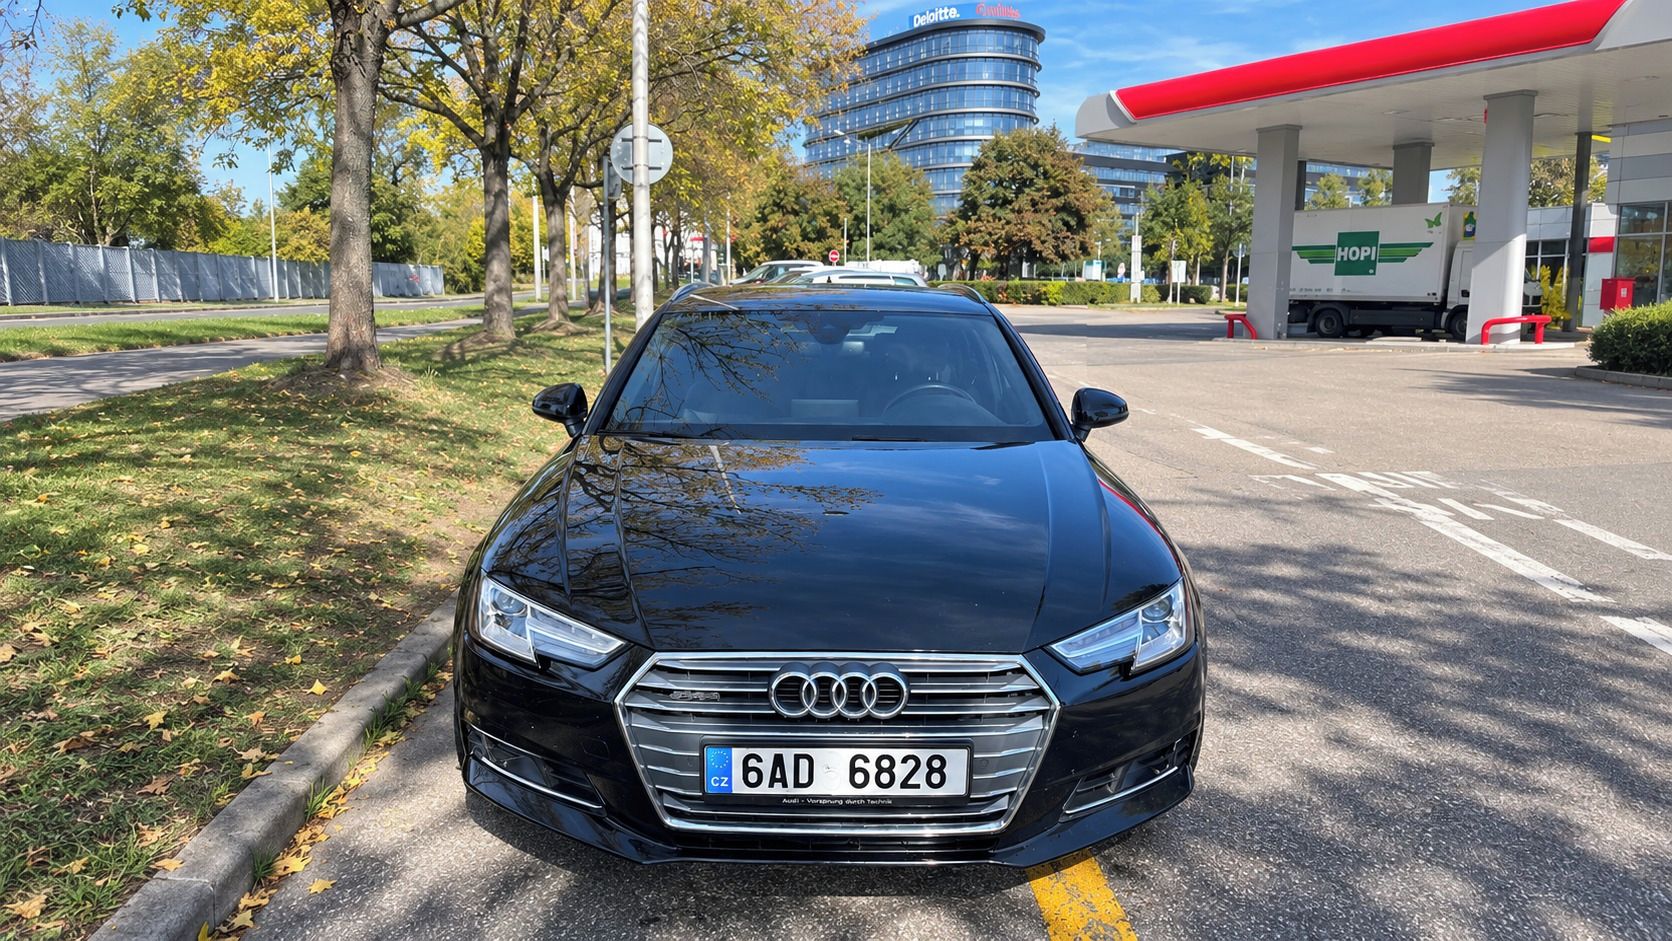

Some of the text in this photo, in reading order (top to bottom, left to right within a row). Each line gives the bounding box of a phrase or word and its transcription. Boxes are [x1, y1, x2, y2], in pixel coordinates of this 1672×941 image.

[913, 6, 961, 28] Deloitte.
[1336, 246, 1377, 261] HOPI
[742, 753, 948, 789] 6AD 6828
[710, 776, 729, 787] CZ
[806, 798, 844, 806] Vorsprung
